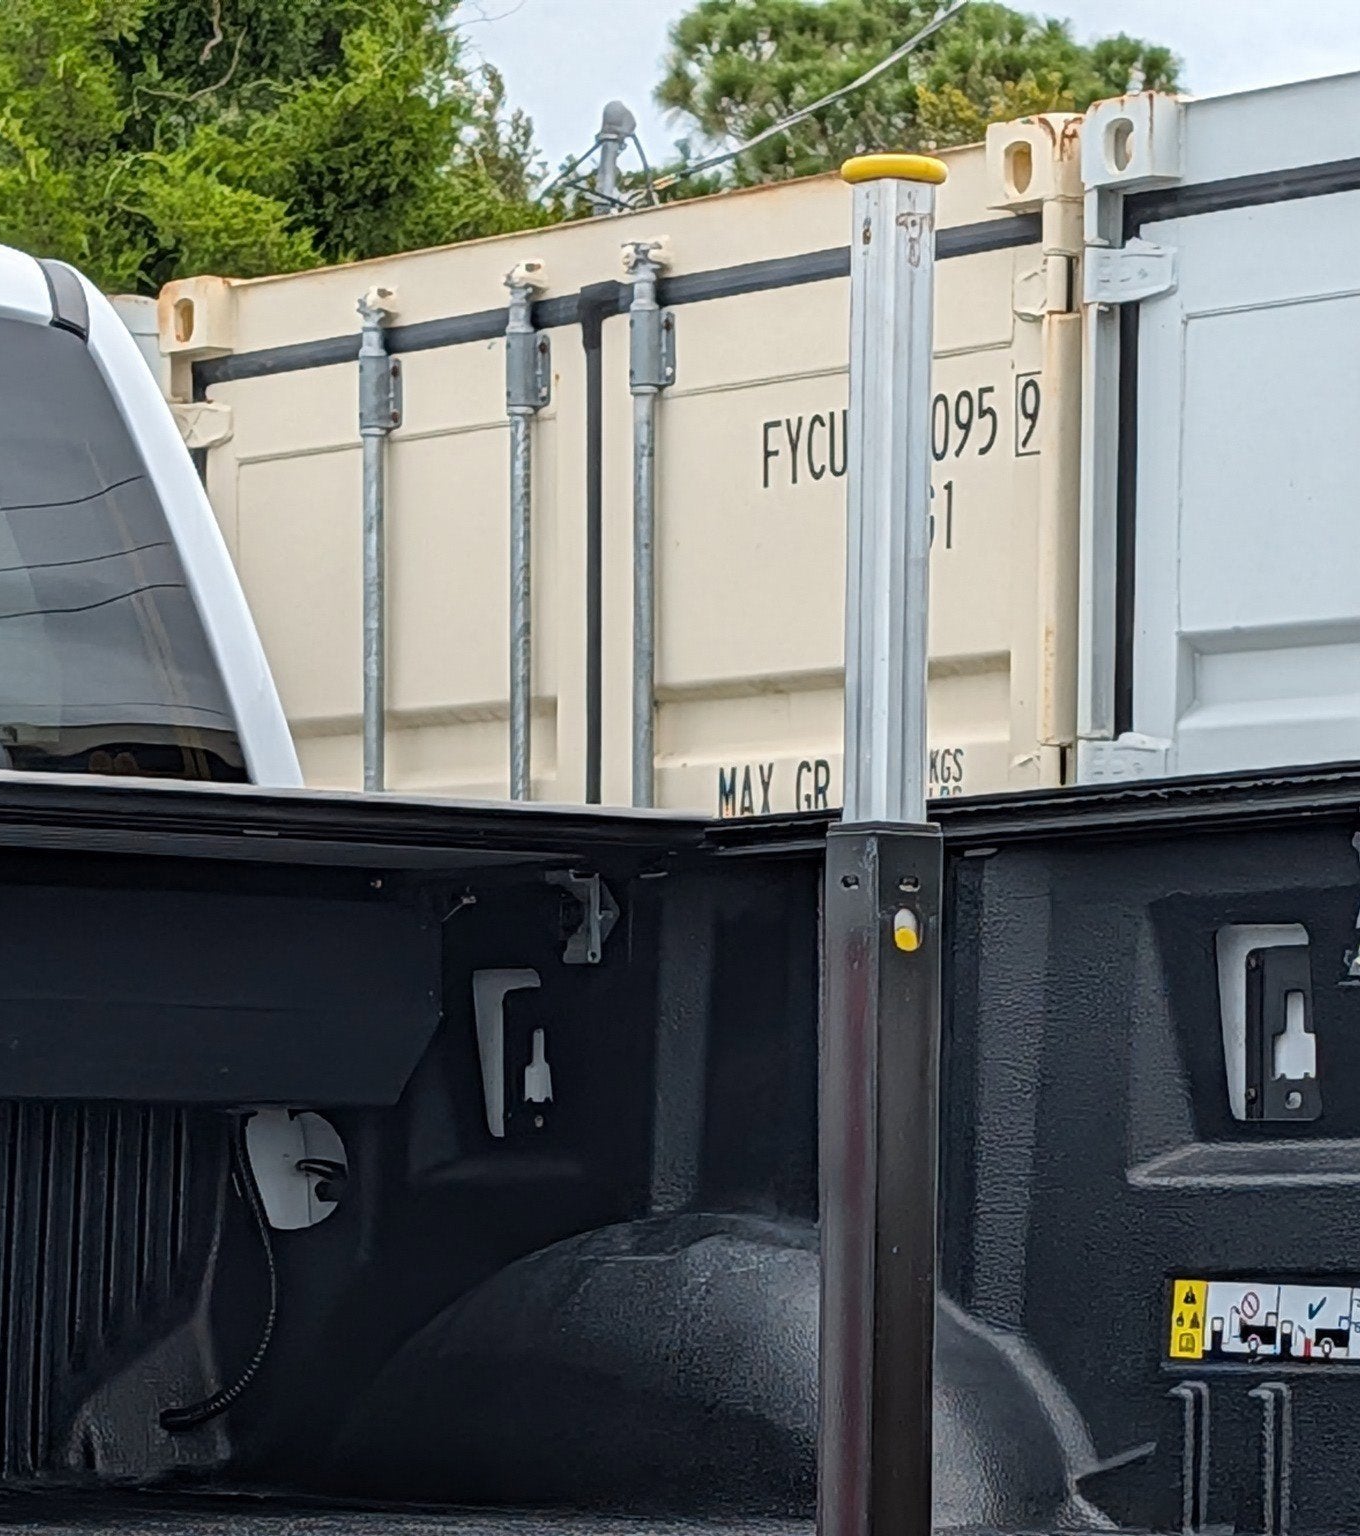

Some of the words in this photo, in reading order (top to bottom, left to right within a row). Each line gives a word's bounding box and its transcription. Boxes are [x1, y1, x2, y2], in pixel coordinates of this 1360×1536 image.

[762, 408, 848, 488] FYCU
[1020, 378, 1041, 449] 9
[718, 761, 775, 819] MAX
[795, 758, 831, 813] GR
[928, 748, 965, 785] KGS
